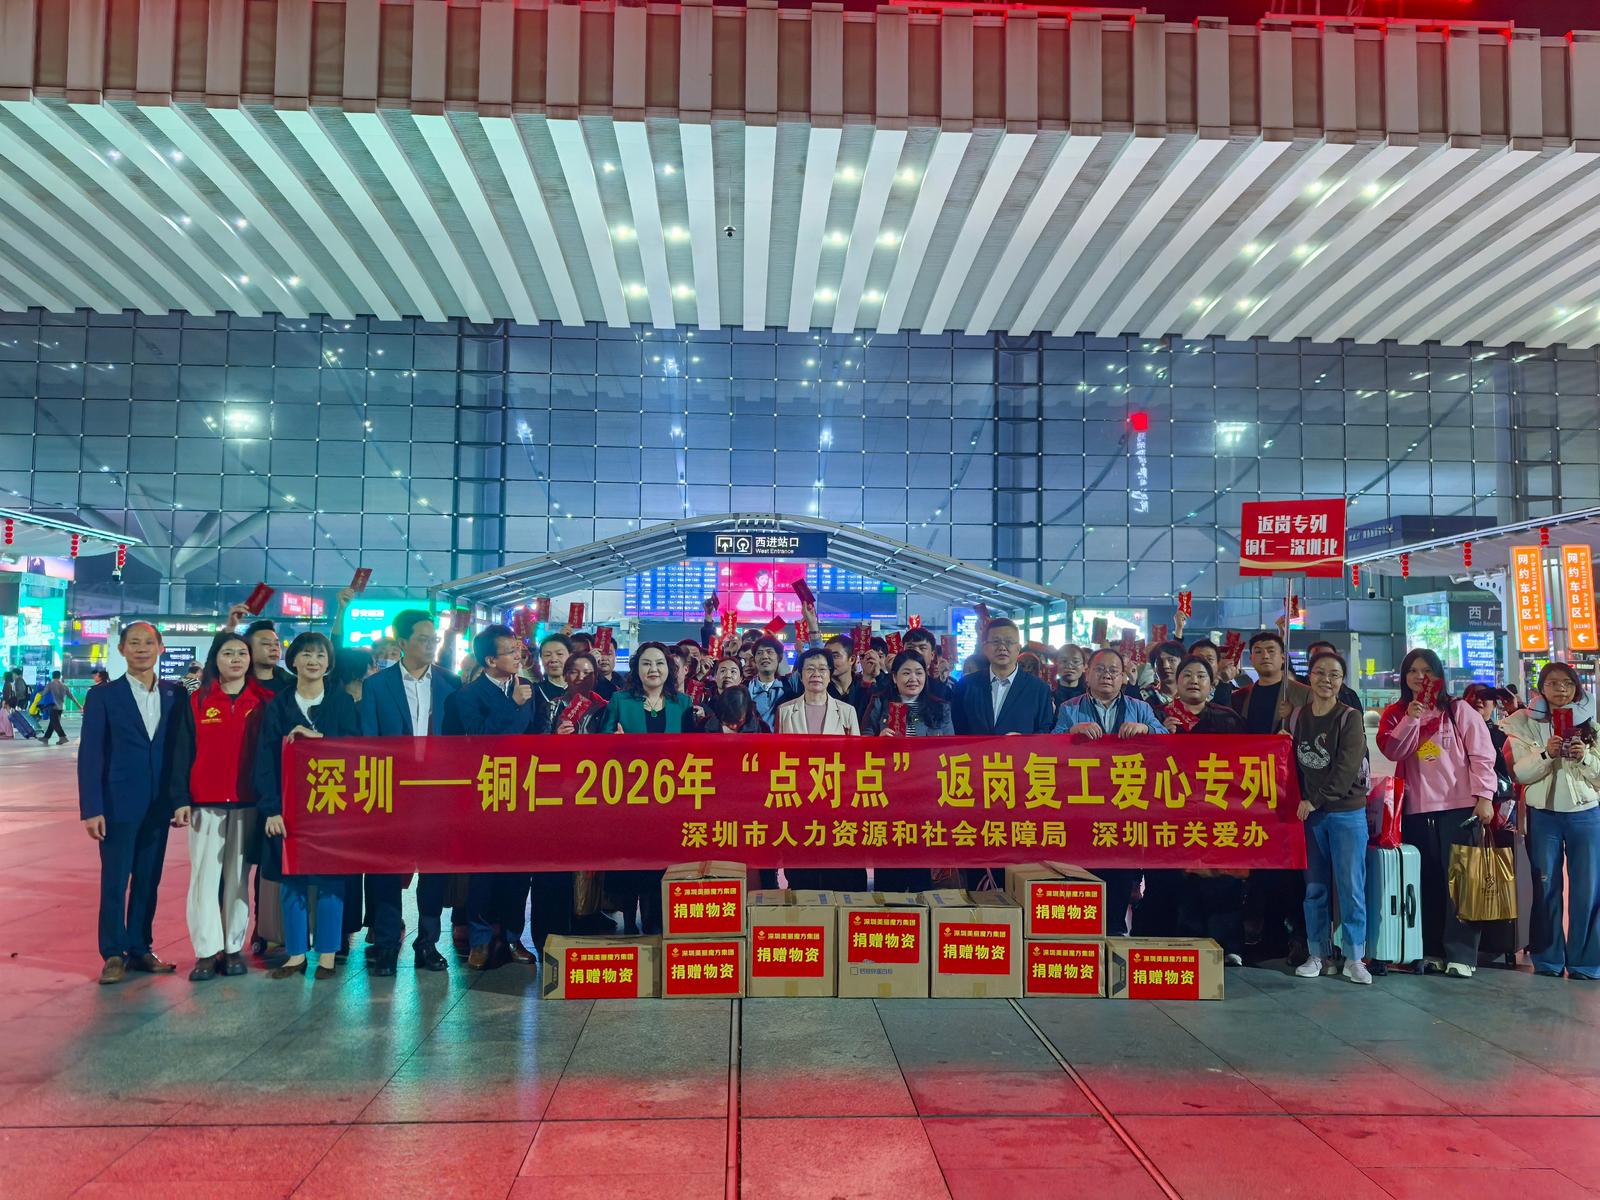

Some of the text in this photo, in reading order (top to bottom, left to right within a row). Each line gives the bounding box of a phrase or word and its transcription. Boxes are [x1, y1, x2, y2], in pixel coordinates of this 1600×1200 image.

[1258, 513, 1328, 535] 返岗专列
[755, 536, 799, 548] 西进站口
[1517, 553, 1533, 620] 网约车B区
[1567, 552, 1582, 619] 网约车B区
[681, 820, 1270, 848] 深圳市人力资源和社会保障局 深圳市关爱办
[673, 902, 737, 918] 捐赠物资
[1035, 904, 1097, 920] 捐赠物资
[853, 932, 915, 948] 捐赠物资
[757, 947, 819, 962] 捐赠物资
[943, 944, 1006, 960] 捐赠物资
[569, 967, 634, 984] 捐赠物资
[671, 963, 734, 979] 捐赠物资
[1032, 963, 1094, 979] 捐赠物资
[1133, 969, 1195, 985] 捐赠物资
